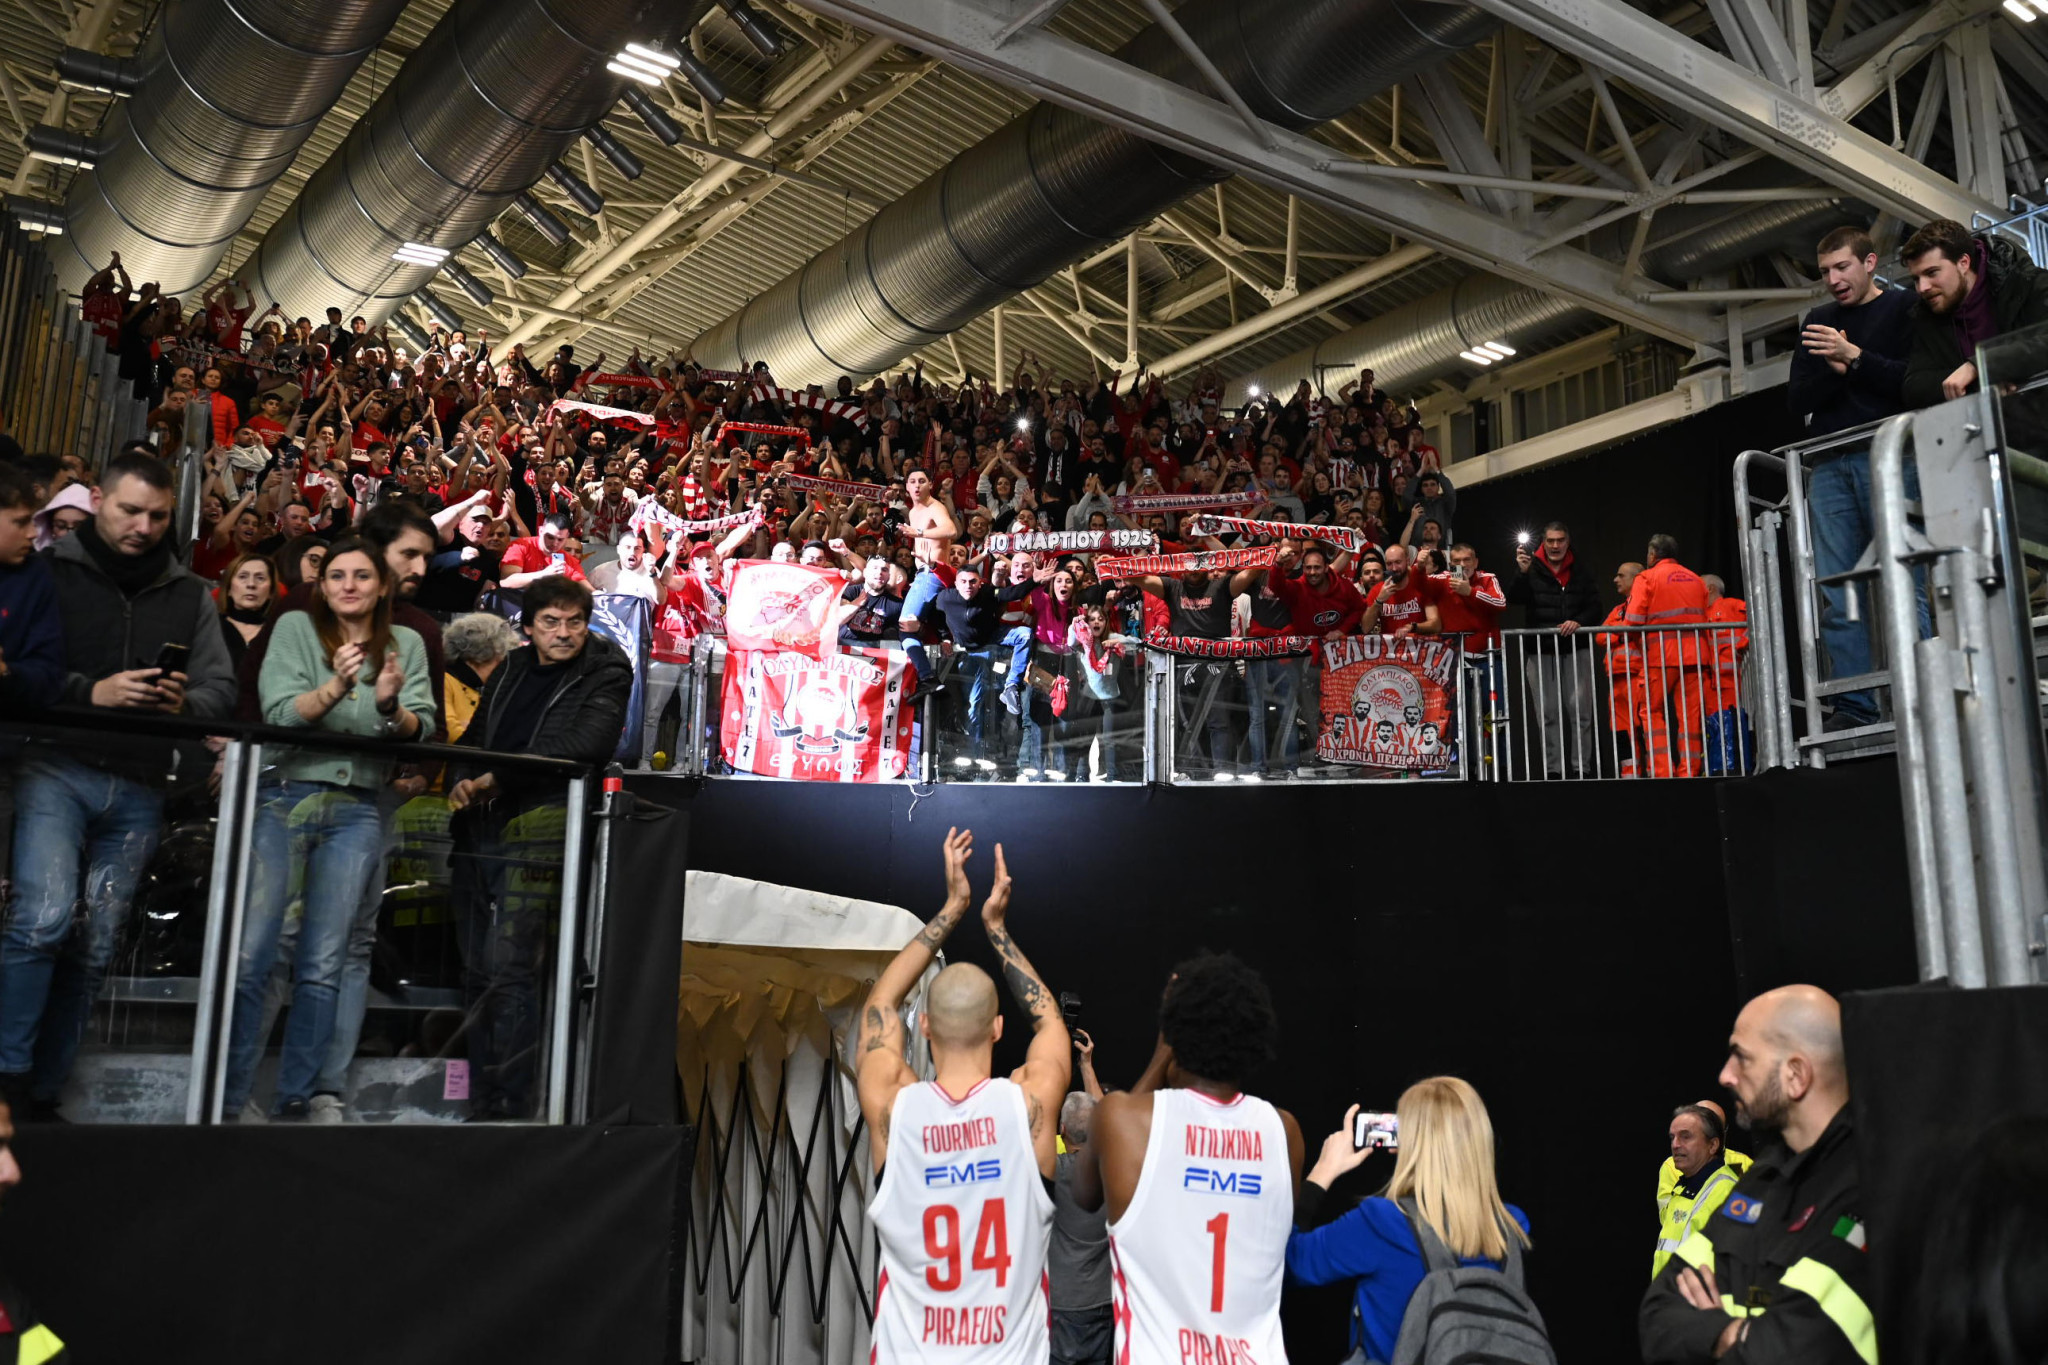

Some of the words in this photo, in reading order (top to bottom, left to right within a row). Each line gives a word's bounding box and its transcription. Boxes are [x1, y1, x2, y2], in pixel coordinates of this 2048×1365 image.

[990, 534, 1008, 551] 10
[1014, 530, 1105, 551] ΜΑΡΤΙΟΥ
[1110, 529, 1152, 548] 1925
[1323, 634, 1455, 682] ΕΛΟΥΝΤΑ
[922, 1116, 997, 1154] FOURNIER
[1184, 1124, 1263, 1162] NTILIKINA
[925, 1159, 1001, 1186] FMS
[1184, 1167, 1262, 1195] FMS
[922, 1198, 1011, 1292] 94
[1206, 1212, 1229, 1313] 1
[922, 1305, 1007, 1346] PIRAEUS
